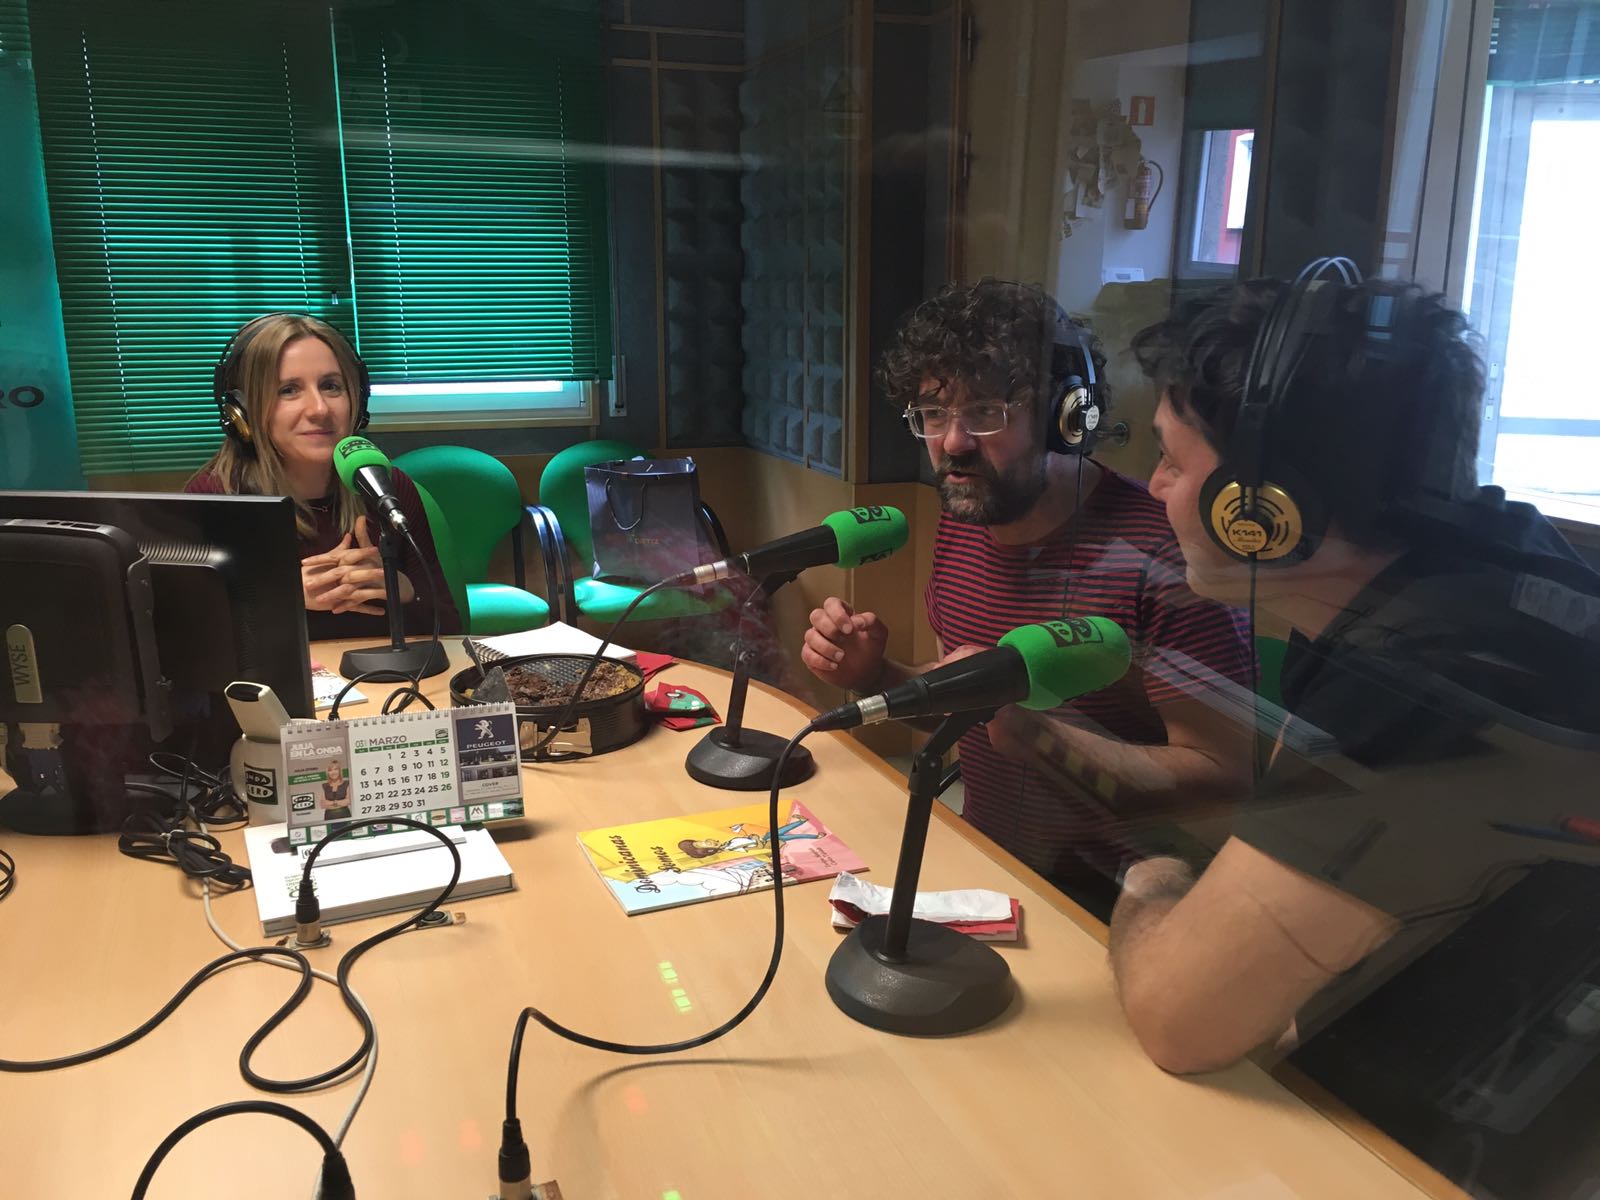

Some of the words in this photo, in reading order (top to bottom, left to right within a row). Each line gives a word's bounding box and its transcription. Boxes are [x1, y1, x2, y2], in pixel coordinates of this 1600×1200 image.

[1232, 529, 1262, 537] K141
[10, 644, 31, 687] WYSE
[369, 735, 407, 745] MARZO
[466, 740, 506, 749] PEUGEOT
[388, 790, 398, 798] 22
